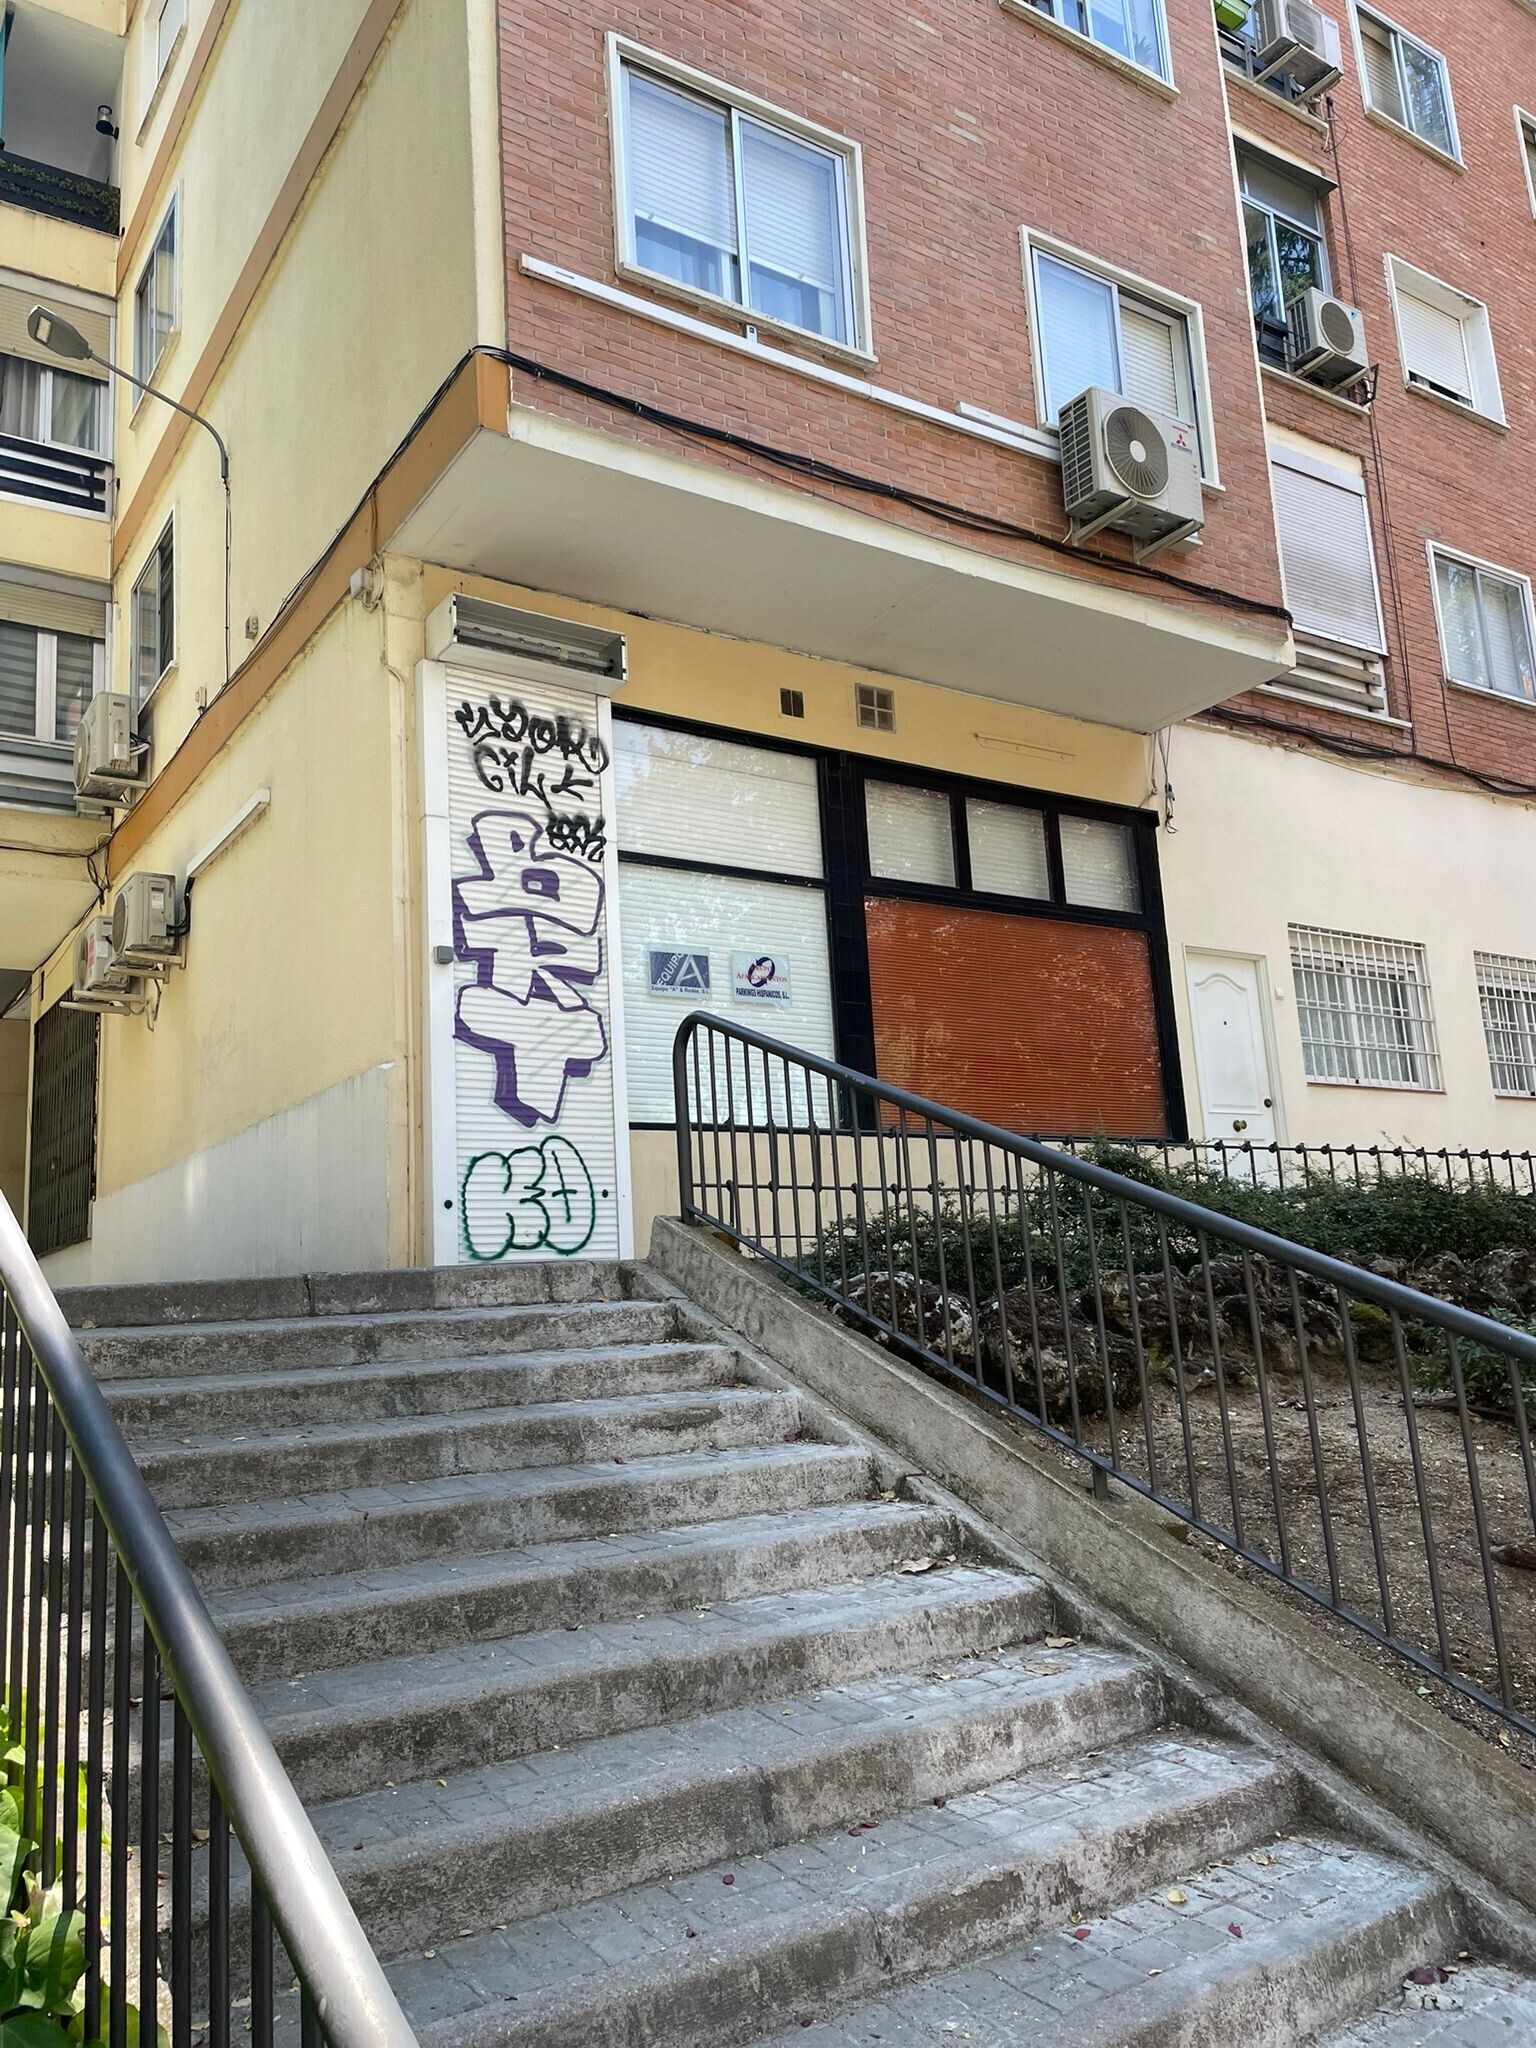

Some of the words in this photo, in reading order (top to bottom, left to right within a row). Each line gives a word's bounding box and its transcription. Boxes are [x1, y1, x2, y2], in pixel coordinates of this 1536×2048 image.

[656, 952, 685, 986] EQUIPO
[673, 953, 707, 988] A
[735, 987, 757, 997] PARKINGS
